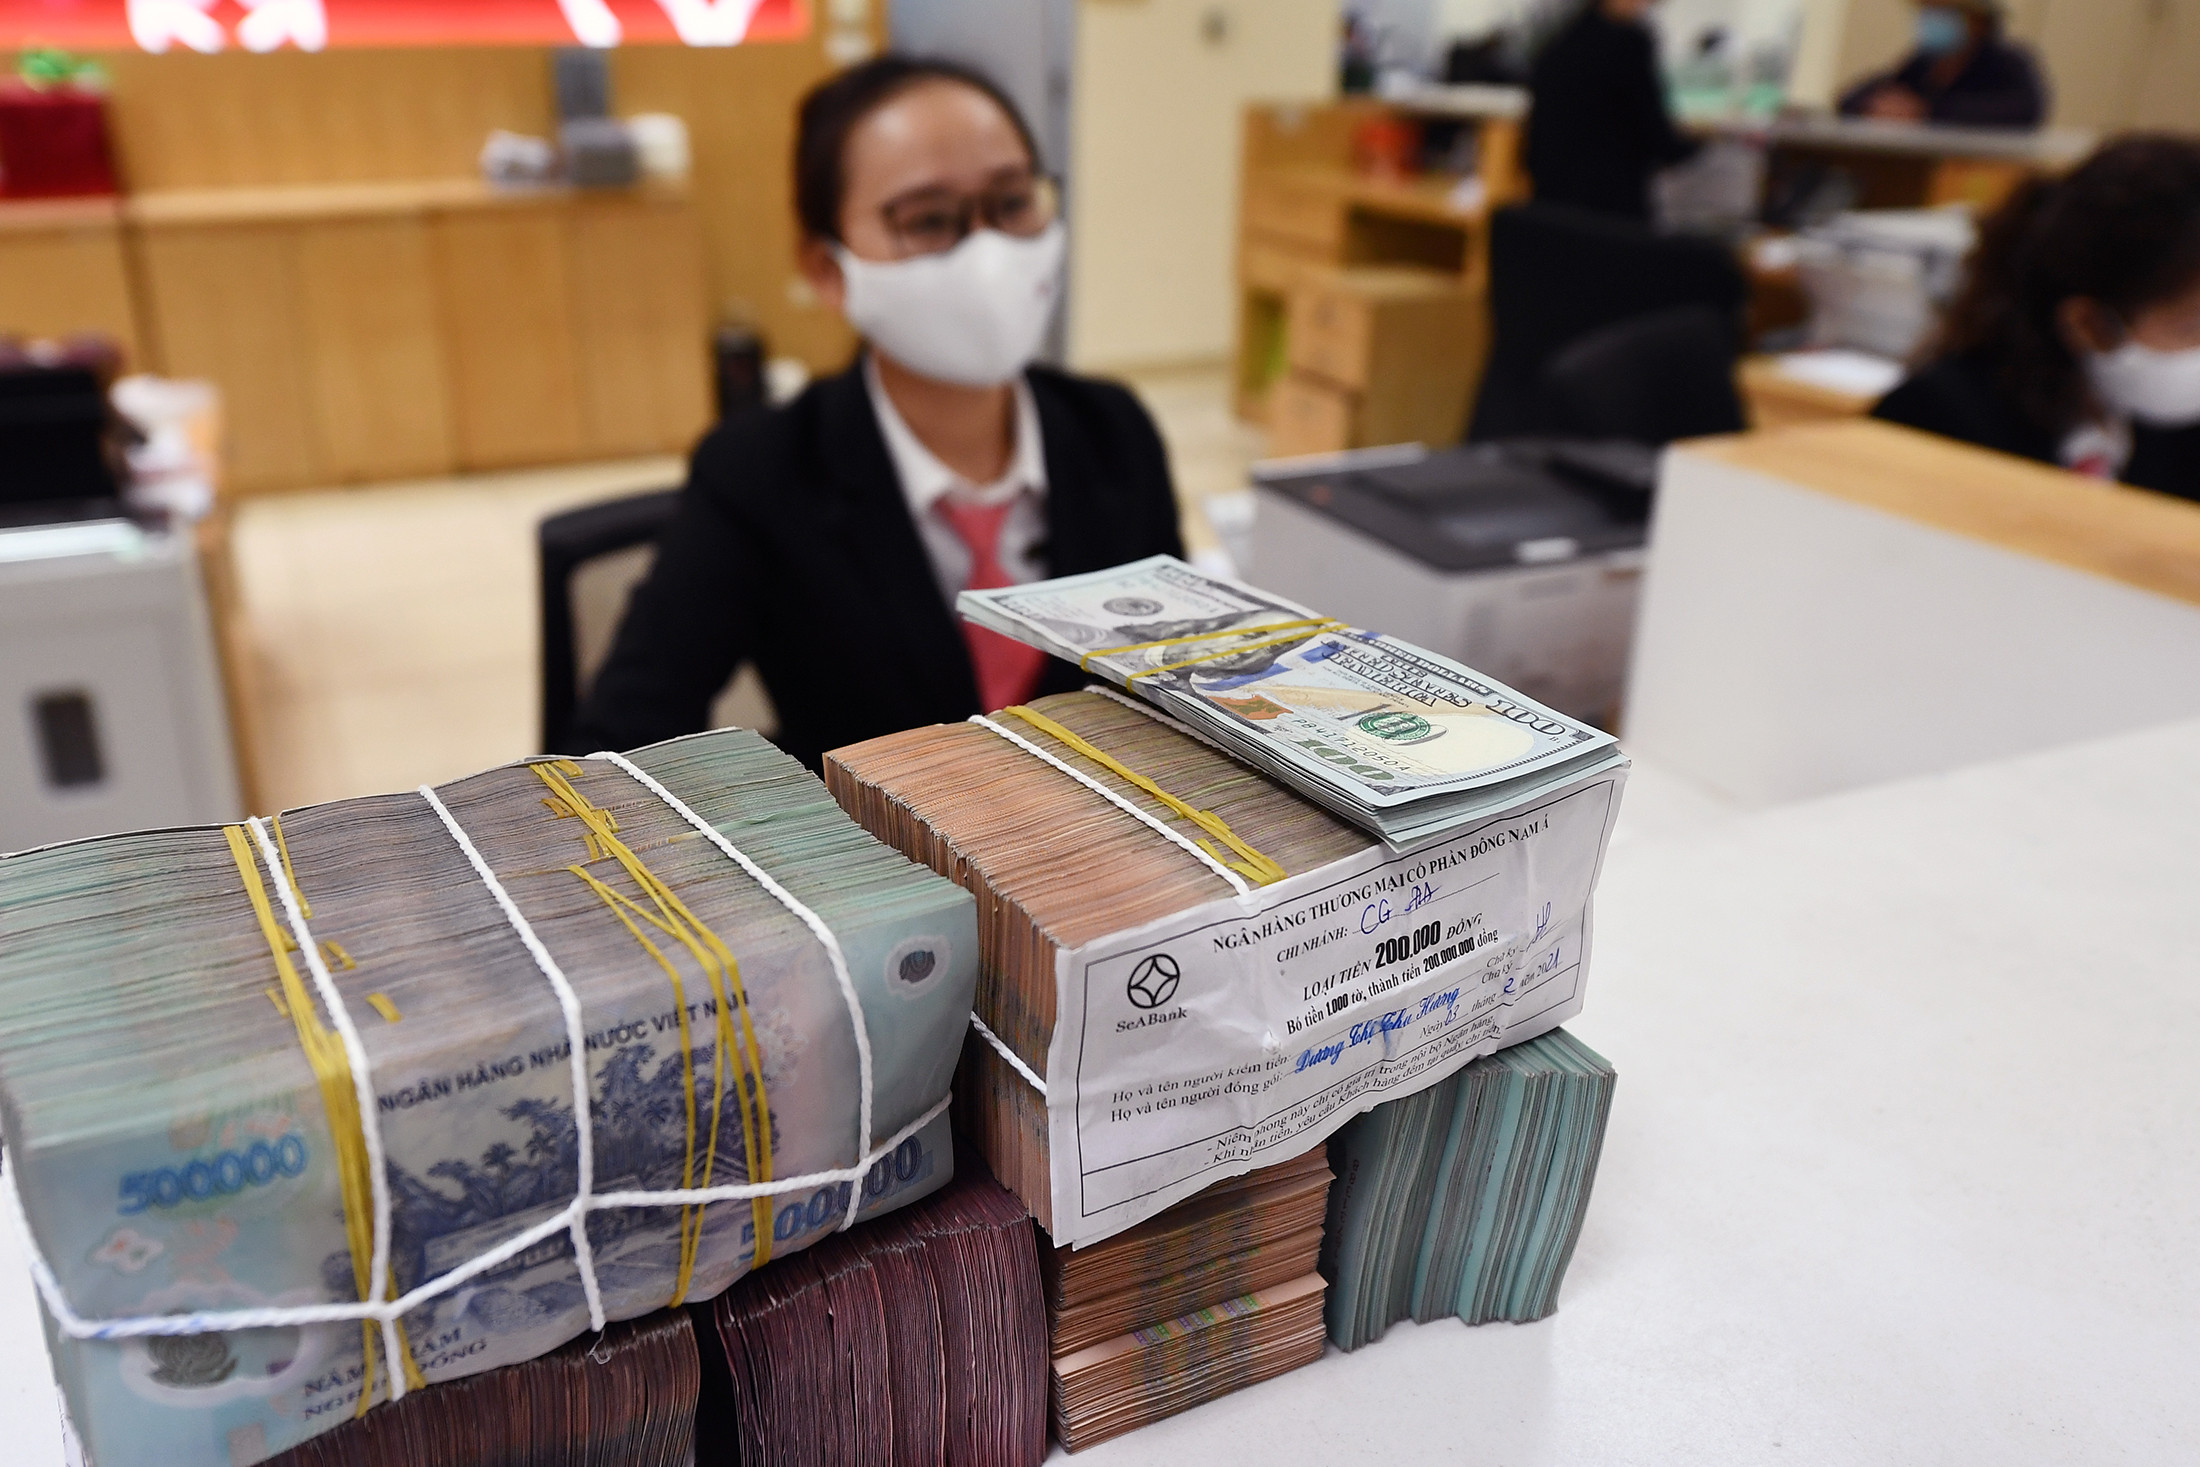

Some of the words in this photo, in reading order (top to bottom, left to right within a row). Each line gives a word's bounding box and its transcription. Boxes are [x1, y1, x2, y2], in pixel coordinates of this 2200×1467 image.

[1485, 699, 1566, 736] 100
[1288, 738, 1396, 782] 100
[1213, 926, 1261, 953] NGÂN
[1261, 910, 1307, 939] HÀNG
[1309, 885, 1373, 921] THƯƠNG
[1374, 874, 1405, 896] MẠI
[1470, 832, 1506, 860] ĐÔNG
[1508, 821, 1540, 844] NAM
[1541, 813, 1550, 831] Á
[1277, 944, 1300, 963] CHI
[1301, 926, 1349, 955] NHÁNH:
[1303, 974, 1337, 1001] LOẠI
[1339, 958, 1372, 984] TIỀN
[1375, 920, 1442, 970] 200.000
[1446, 912, 1483, 941] ĐỒNG
[1286, 1015, 1303, 1036] Bó
[1304, 1005, 1325, 1027] tiền
[1326, 992, 1349, 1017] 1.000
[1351, 988, 1368, 1005] tờ,
[1367, 973, 1400, 997] thành
[1402, 963, 1422, 984] tiền
[1422, 936, 1476, 973] 200.000.000
[1477, 928, 1499, 950] đồng
[1470, 992, 1497, 1013] tháng
[1503, 977, 1518, 995] 2
[1115, 1007, 1189, 1034] SeABank
[1295, 1040, 1345, 1075] Dương
[1380, 1008, 1413, 1033] Thu
[1415, 987, 1461, 1020] Hương
[377, 1075, 453, 1114] NGÂN
[456, 1050, 525, 1091] HÀNG
[583, 1018, 649, 1052] NƯỚC
[1112, 1089, 1134, 1105] Họ
[1138, 1083, 1154, 1097] và
[1158, 1078, 1180, 1094] tên
[1183, 1069, 1224, 1090] người
[1110, 1107, 1133, 1123] Họ
[1135, 1101, 1152, 1115] và
[1156, 1096, 1177, 1111] tên
[1181, 1084, 1221, 1106] người
[1224, 1080, 1260, 1096] đóng
[1213, 1146, 1237, 1164] Khi
[1296, 1113, 1317, 1134] yêu
[1337, 1081, 1370, 1105] Khách
[1372, 1073, 1402, 1089] hàng
[1215, 1134, 1252, 1150] Niêm
[1290, 1105, 1311, 1122] này
[1331, 1085, 1344, 1099] có
[1379, 1059, 1408, 1076] trong
[117, 1133, 309, 1217] 500000
